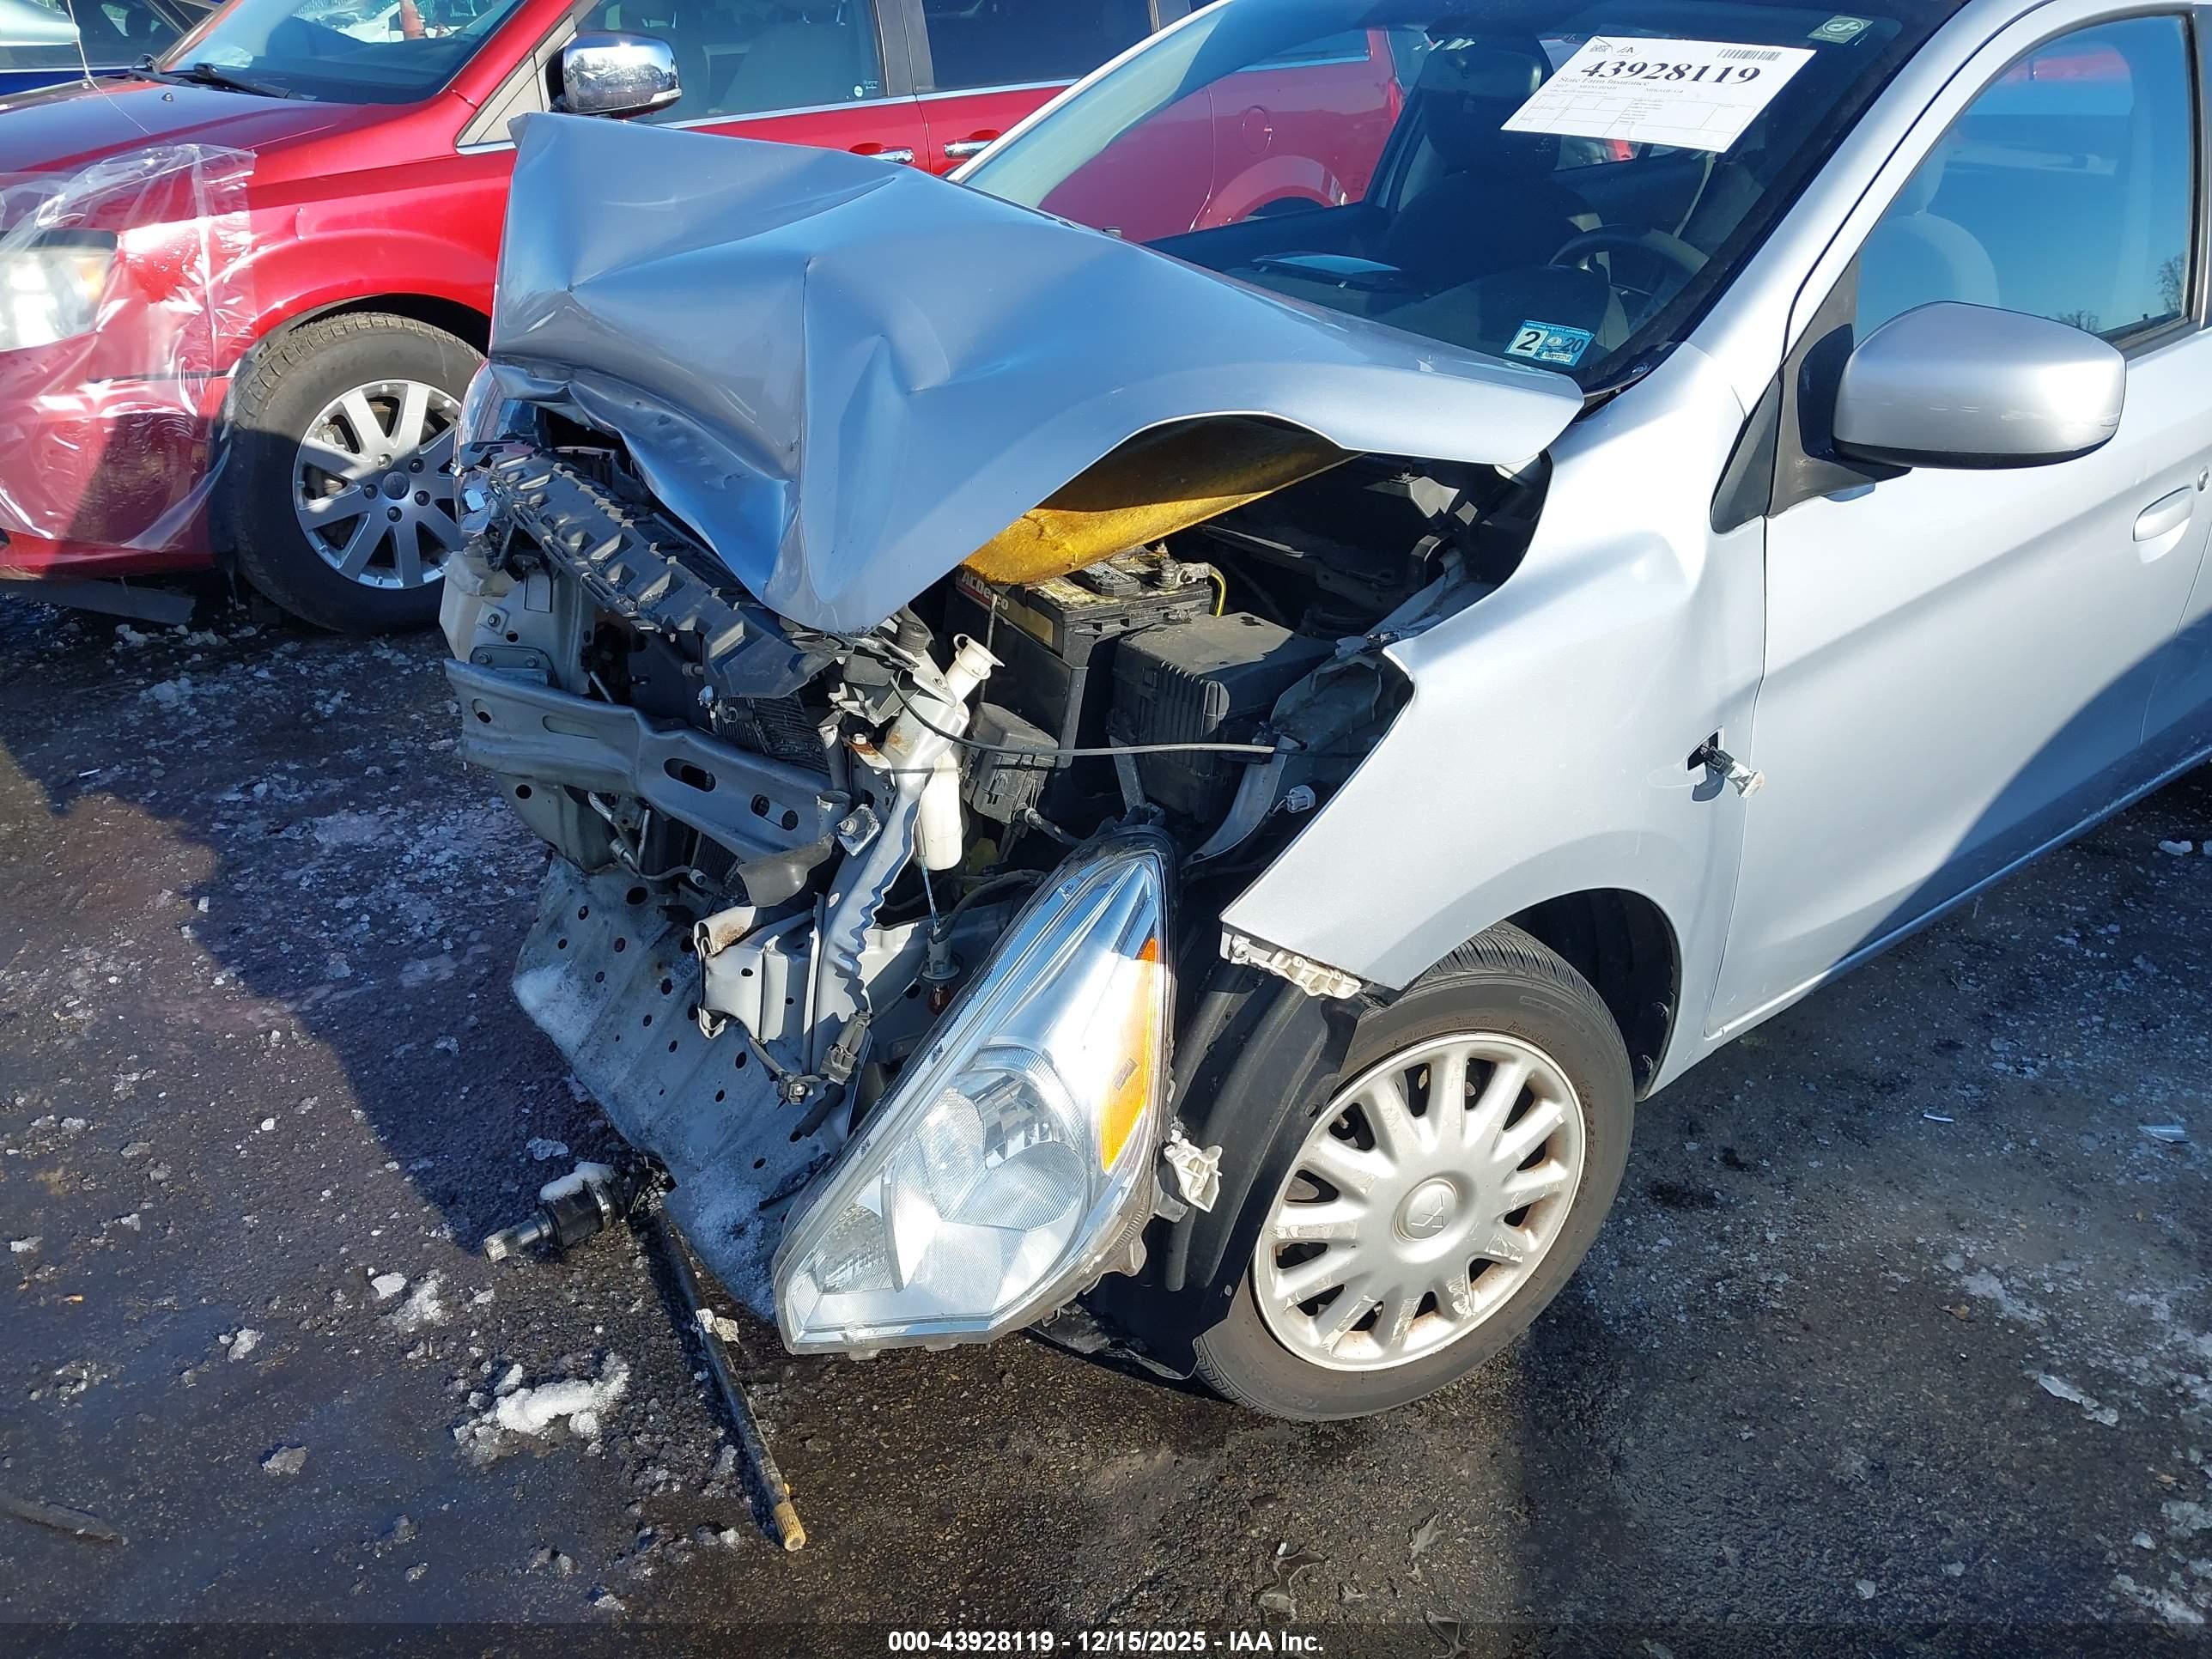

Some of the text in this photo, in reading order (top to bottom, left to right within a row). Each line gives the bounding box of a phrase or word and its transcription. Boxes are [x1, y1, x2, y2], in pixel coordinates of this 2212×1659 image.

[1581, 60, 1760, 84] 43928119
[1516, 331, 1540, 351] 2
[1559, 337, 1584, 353] 20
